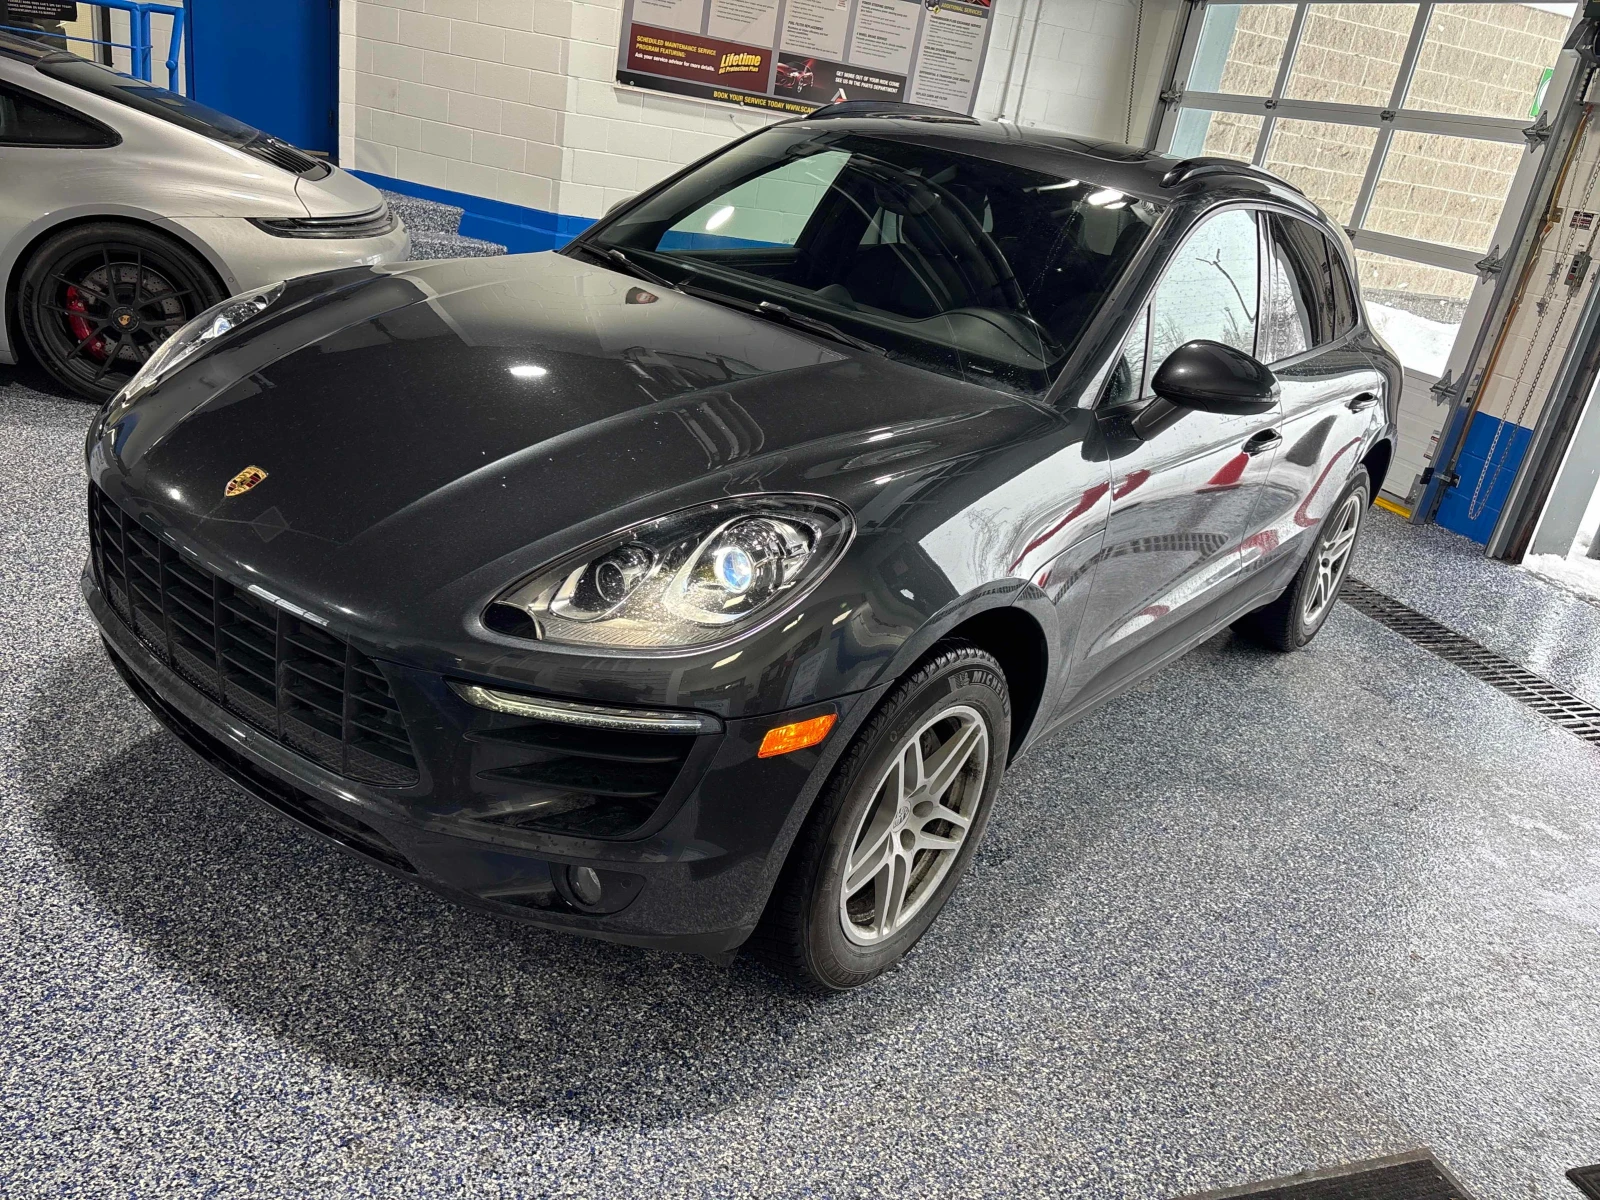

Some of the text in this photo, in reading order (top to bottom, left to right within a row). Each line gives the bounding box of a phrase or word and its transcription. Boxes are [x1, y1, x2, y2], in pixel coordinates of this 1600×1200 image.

[941, 3, 982, 16] ADDITIONAL SERVICES
[636, 36, 716, 56] SCHEDULED MAINTENANCE SERVICE
[636, 43, 686, 58] PROGRAM FEATURING:
[668, 58, 683, 66] advisor
[701, 64, 715, 72] details.
[720, 52, 761, 67] Lifetime
[873, 85, 898, 94] DEPARTMENT
[713, 91, 729, 100] BOOK
[729, 92, 743, 101] YOUR
[744, 96, 767, 106] SERVICE
[768, 100, 785, 109] TODAY
[972, 671, 1009, 714] MICHELIN
